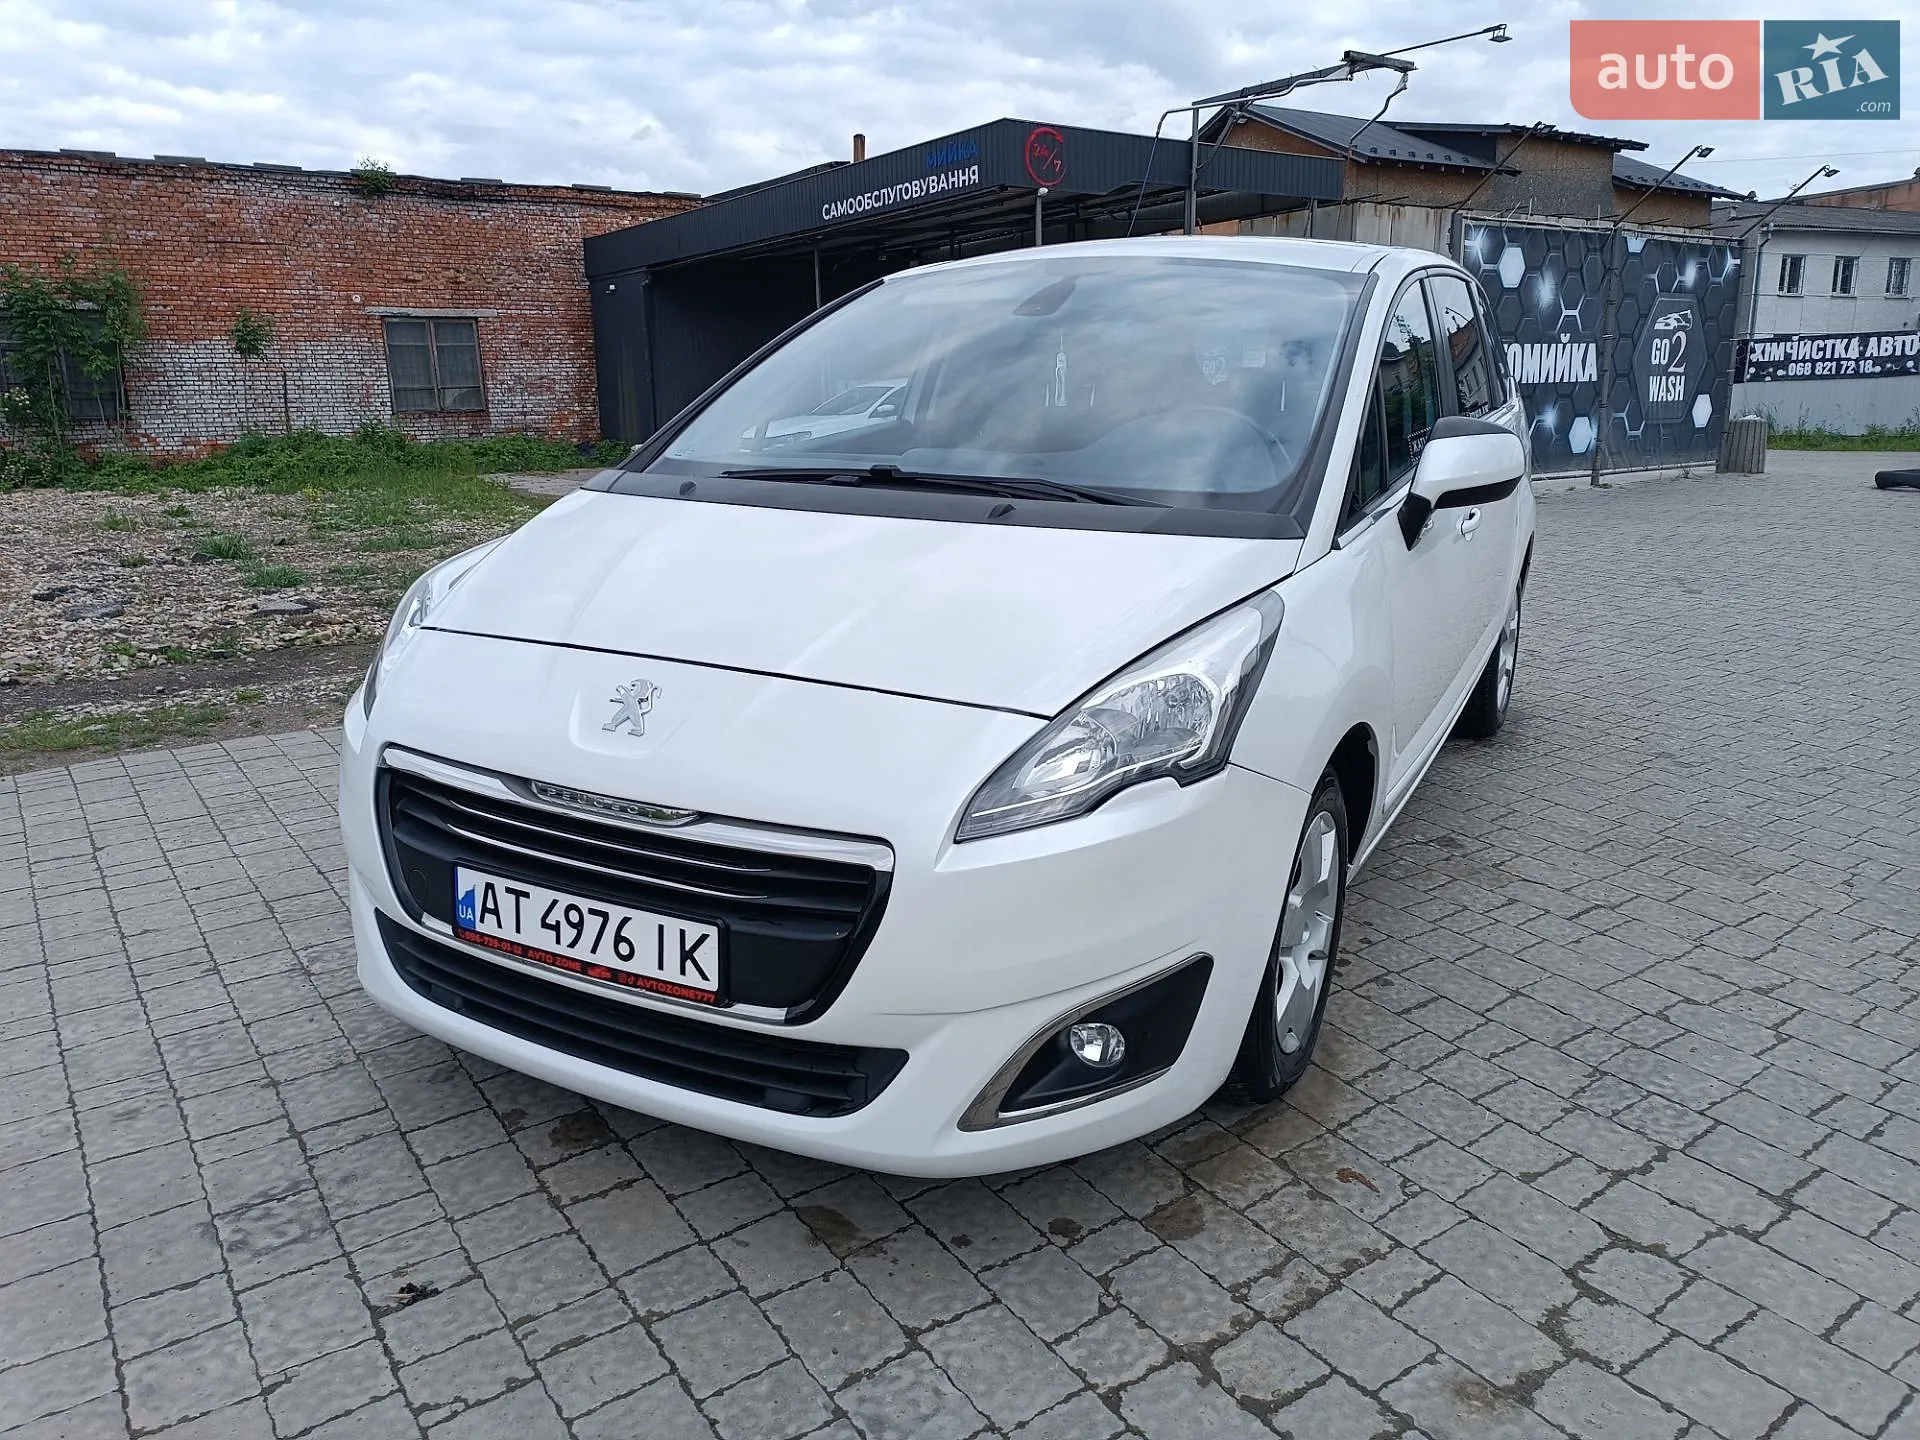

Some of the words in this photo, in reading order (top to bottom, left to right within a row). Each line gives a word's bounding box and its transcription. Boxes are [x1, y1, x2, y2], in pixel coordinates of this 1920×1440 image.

[822, 165, 979, 220] САМООБСЛУГОВУВАННЯ
[1503, 332, 1598, 384] ОМИЙКА
[1651, 338, 1669, 365] GO
[1668, 331, 1687, 373] 2
[1865, 335, 1919, 357] АВТО
[1788, 362, 1812, 376] 068
[1815, 361, 1837, 375] 821
[1840, 360, 1855, 374] 72
[1859, 360, 1873, 373] 18
[1649, 376, 1685, 401] WASH
[459, 905, 474, 921] UA
[479, 881, 531, 934] AT
[540, 899, 637, 962] 4976
[657, 923, 711, 982] IK
